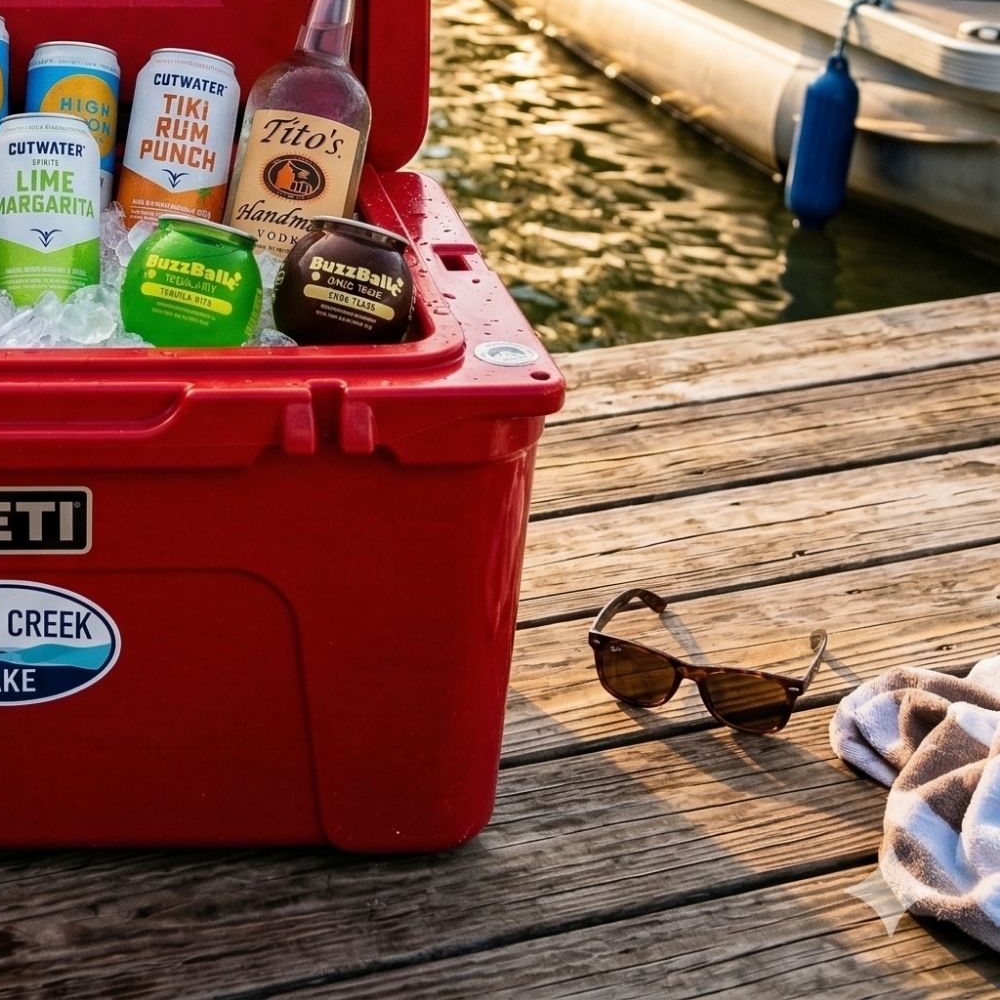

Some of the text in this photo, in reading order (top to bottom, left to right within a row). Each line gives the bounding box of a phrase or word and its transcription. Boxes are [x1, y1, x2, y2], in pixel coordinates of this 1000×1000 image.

[154, 73, 223, 97] CUTWATER
[87, 118, 111, 136] ON
[155, 117, 209, 145] RUM
[9, 141, 82, 157] CUTWATER
[139, 139, 216, 172] PUNCH
[17, 169, 75, 193] LIME
[236, 200, 312, 232] Handm
[257, 229, 299, 244] VODK
[7, 609, 92, 639] CREEK
